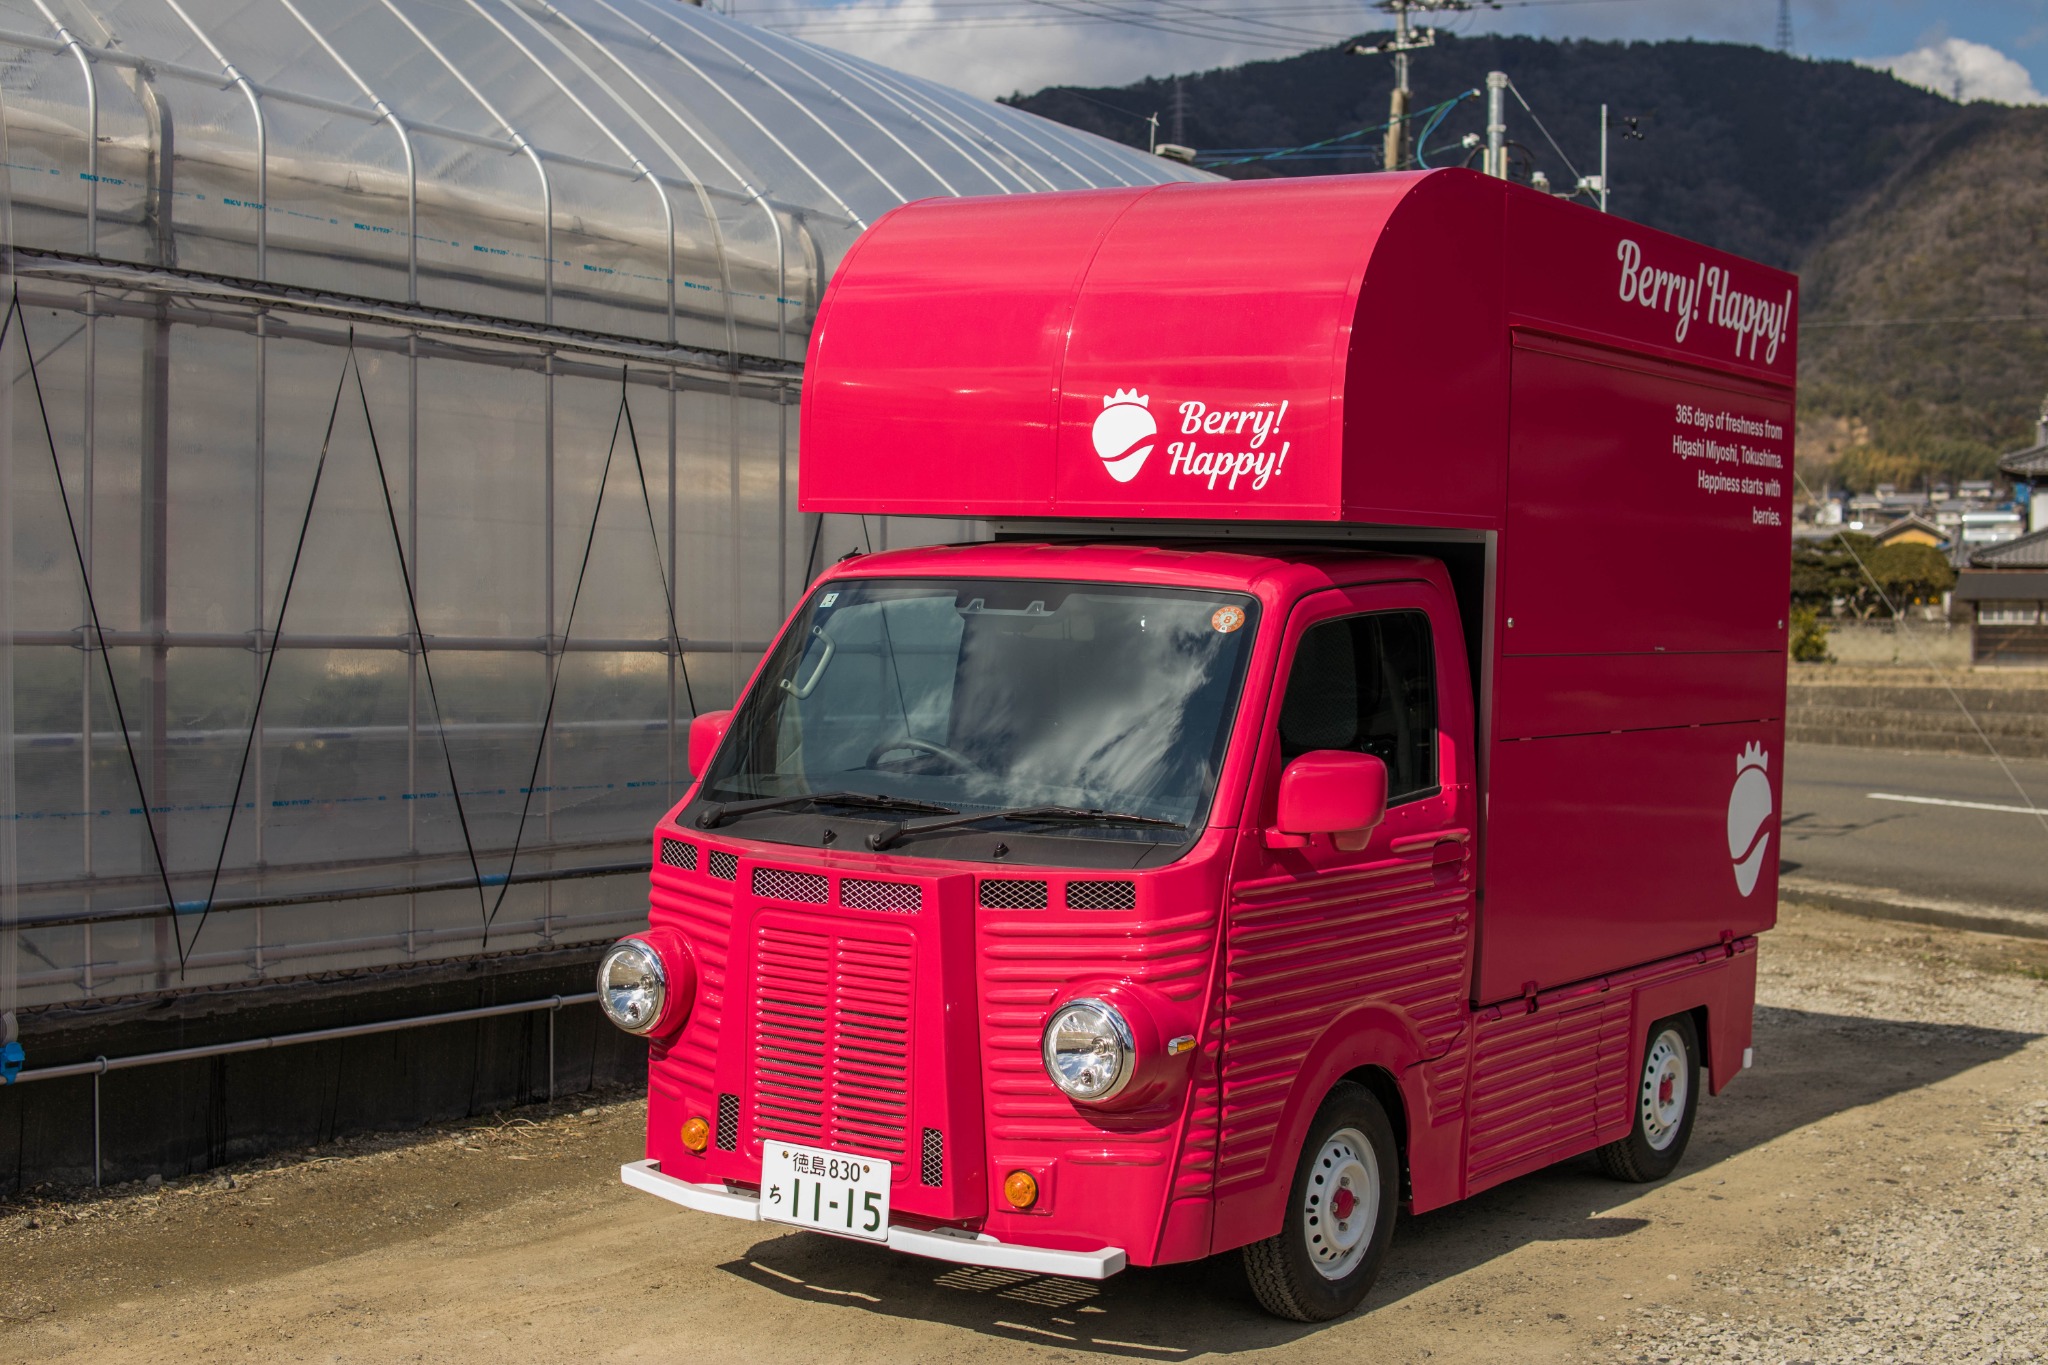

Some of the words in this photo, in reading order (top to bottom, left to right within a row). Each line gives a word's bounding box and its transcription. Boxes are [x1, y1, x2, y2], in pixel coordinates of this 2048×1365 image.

[1616, 238, 1706, 343] Berry!
[1706, 266, 1792, 365] Happy!
[1178, 399, 1289, 449] Berry!
[1675, 403, 1693, 424] 365
[1694, 407, 1715, 432] days
[1715, 411, 1725, 430] of
[1725, 412, 1764, 437] freshness
[1764, 419, 1783, 440] from
[1167, 441, 1290, 491] Happy!
[1672, 434, 1705, 460] Higashi
[1706, 440, 1739, 467] Miyoshi,
[1741, 445, 1784, 469] Tokushima.
[1698, 469, 1740, 495] Happiness
[1741, 476, 1764, 496] starts
[1764, 479, 1781, 498] with
[1752, 506, 1782, 526] berries.
[793, 1152, 826, 1177] 徳島
[829, 1158, 861, 1182] 830
[769, 1183, 782, 1204] ち
[792, 1178, 882, 1232] 11-15
